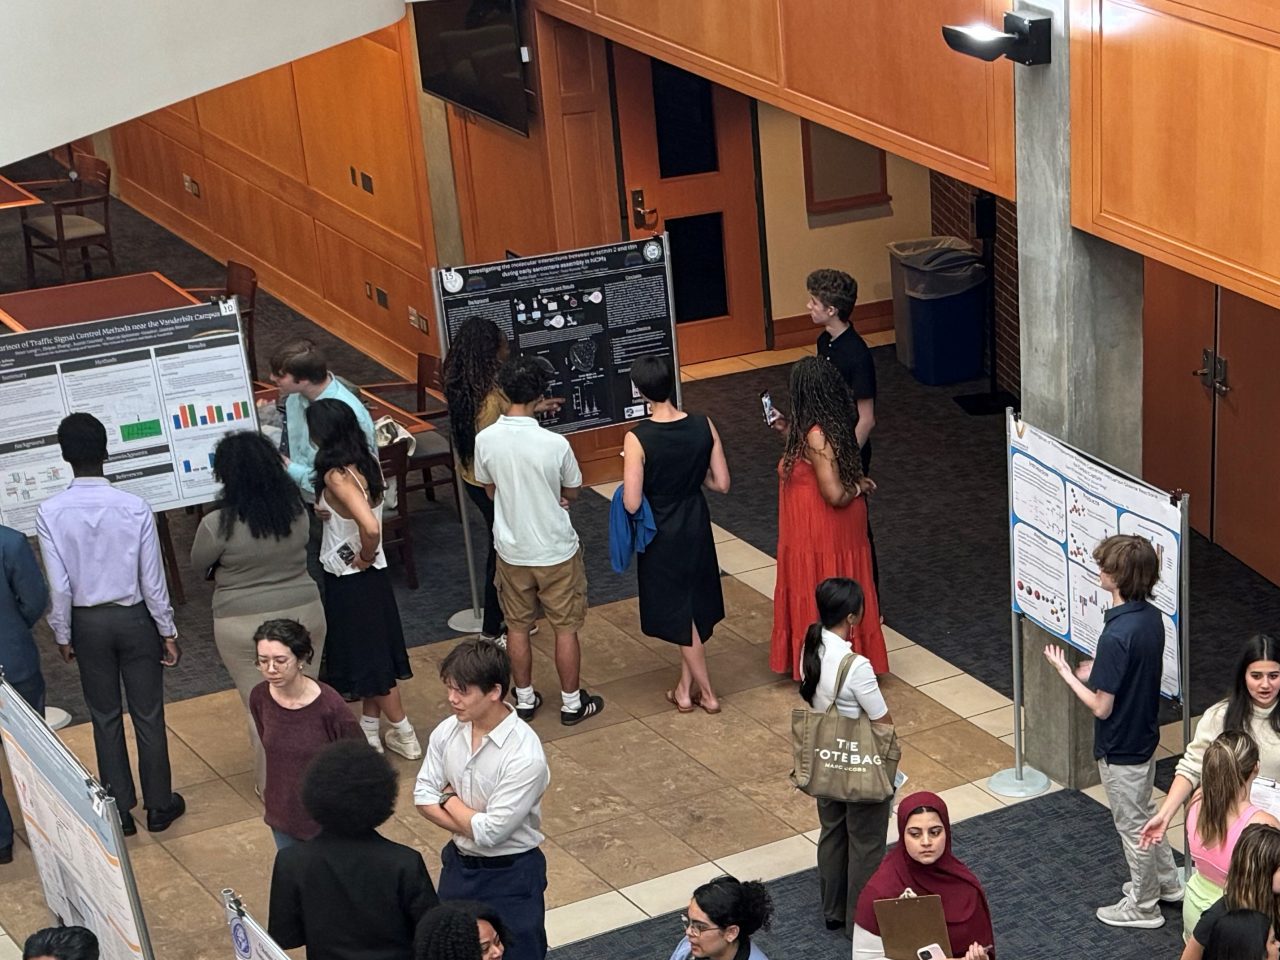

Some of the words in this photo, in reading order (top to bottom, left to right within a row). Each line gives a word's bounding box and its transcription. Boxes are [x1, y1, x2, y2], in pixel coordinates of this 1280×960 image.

[223, 304, 234, 313] 10
[30, 338, 52, 347] Traffic
[54, 334, 76, 345] Signal
[76, 330, 102, 341] Control
[102, 324, 132, 336] Methods
[148, 320, 160, 328] the
[160, 315, 194, 326] Vanderbilt
